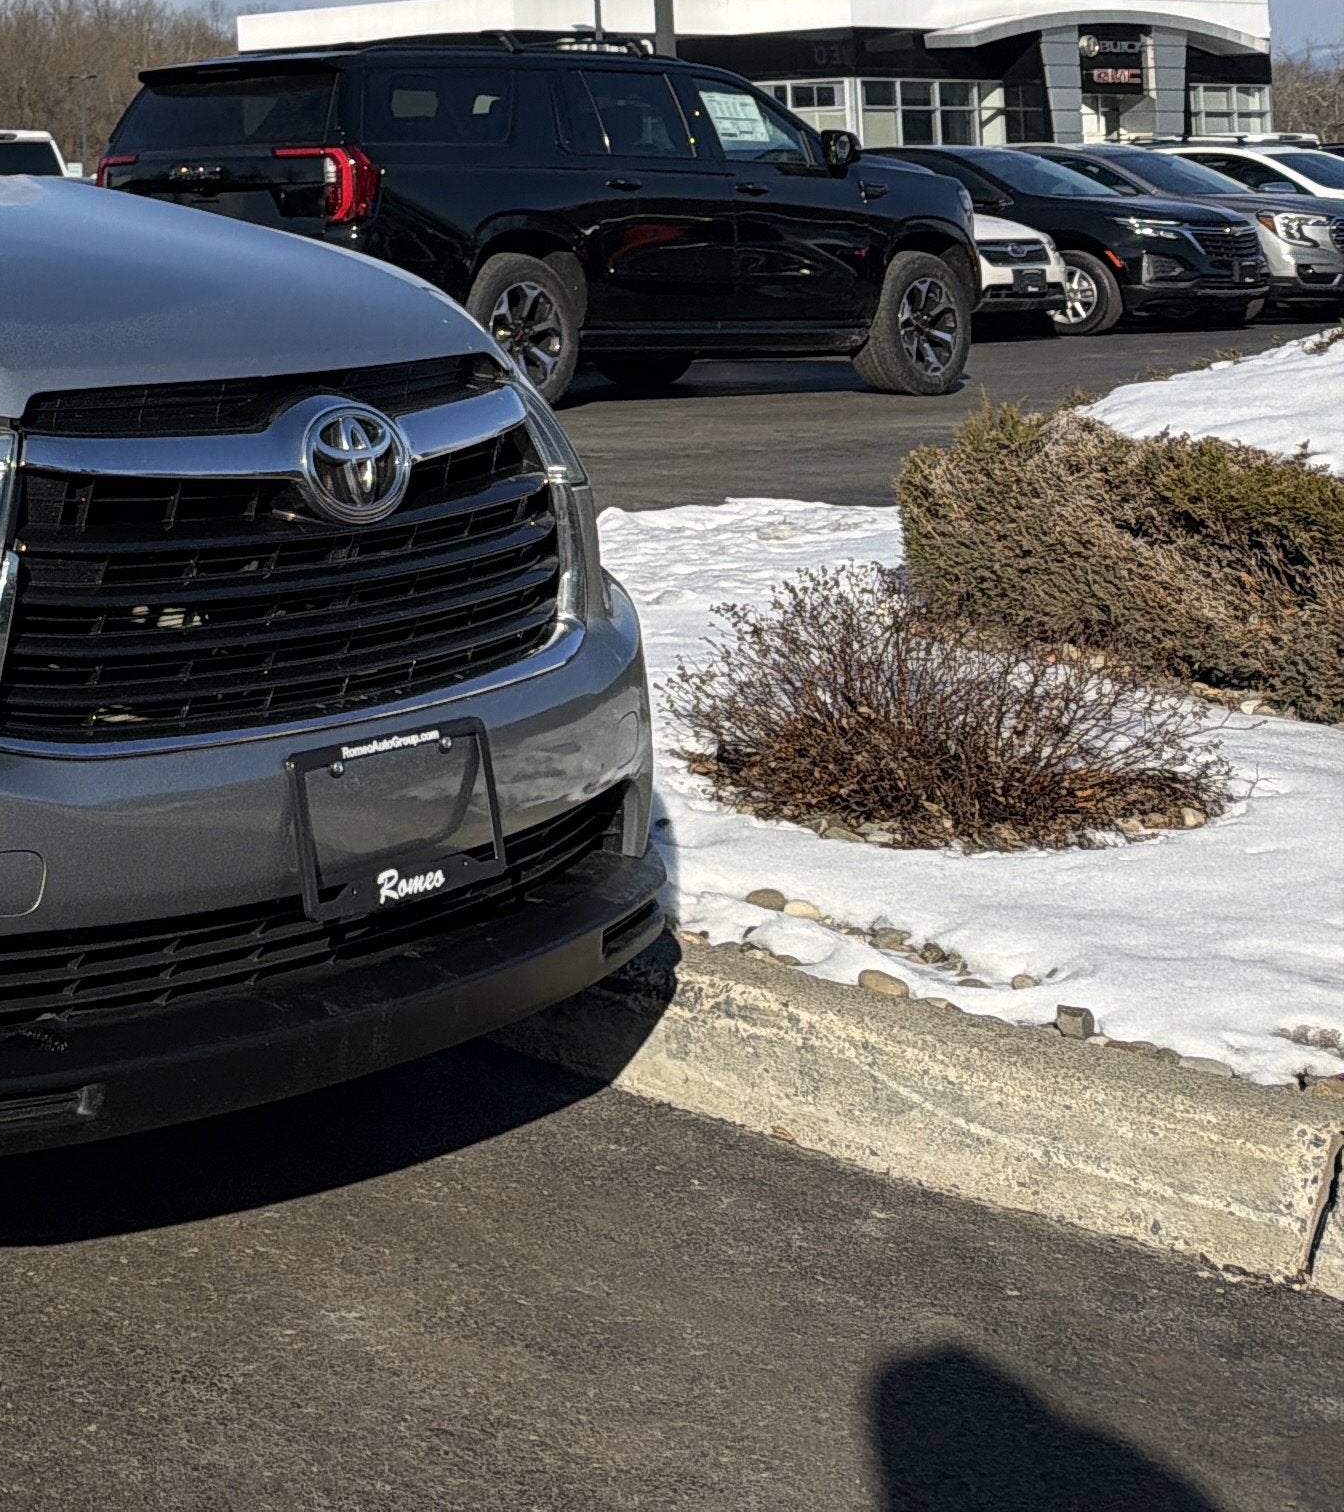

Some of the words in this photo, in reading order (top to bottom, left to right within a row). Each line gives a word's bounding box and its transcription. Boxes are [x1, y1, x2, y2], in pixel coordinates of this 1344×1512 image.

[1093, 68, 1141, 84] GMC
[341, 729, 440, 759] RomeoAutoGroup.com
[377, 868, 445, 905] Romeo
